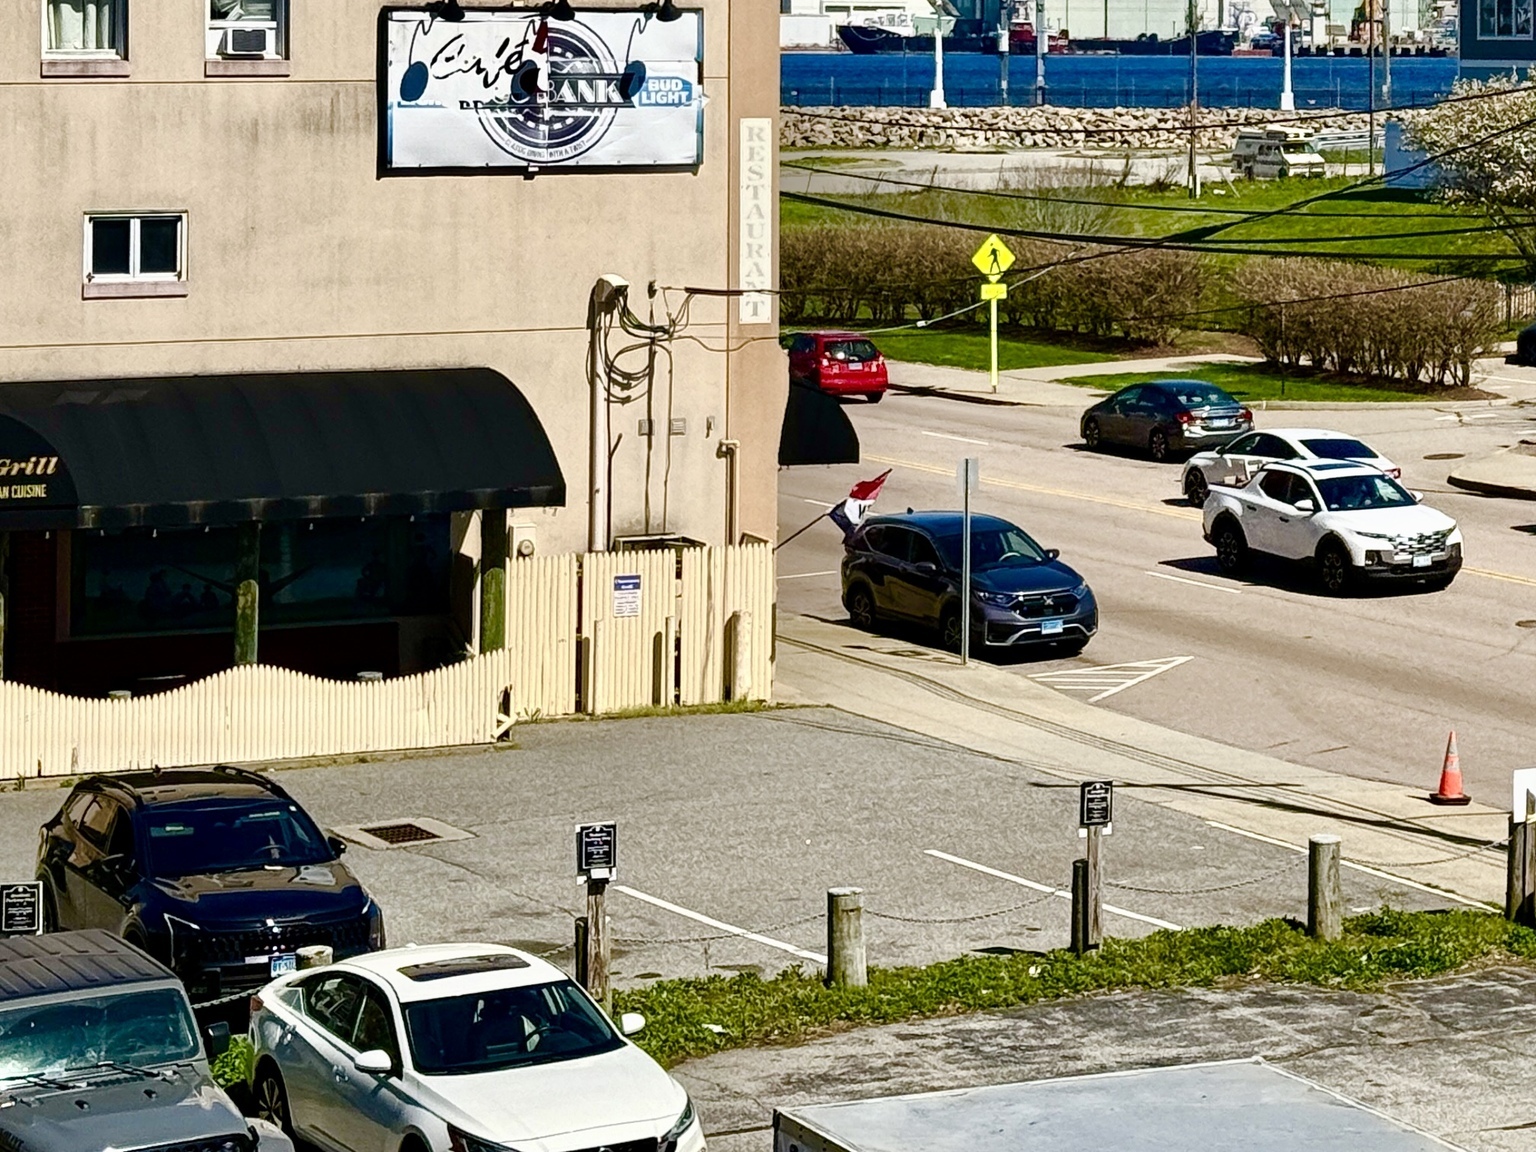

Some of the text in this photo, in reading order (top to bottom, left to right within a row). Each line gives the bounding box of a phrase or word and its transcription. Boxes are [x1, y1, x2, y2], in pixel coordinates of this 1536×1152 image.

[647, 78, 684, 92] BUD
[641, 91, 690, 105] LIGHT
[745, 125, 765, 317] RESTAURANT
[0, 456, 58, 476] Grill
[11, 484, 47, 498] CUISINE
